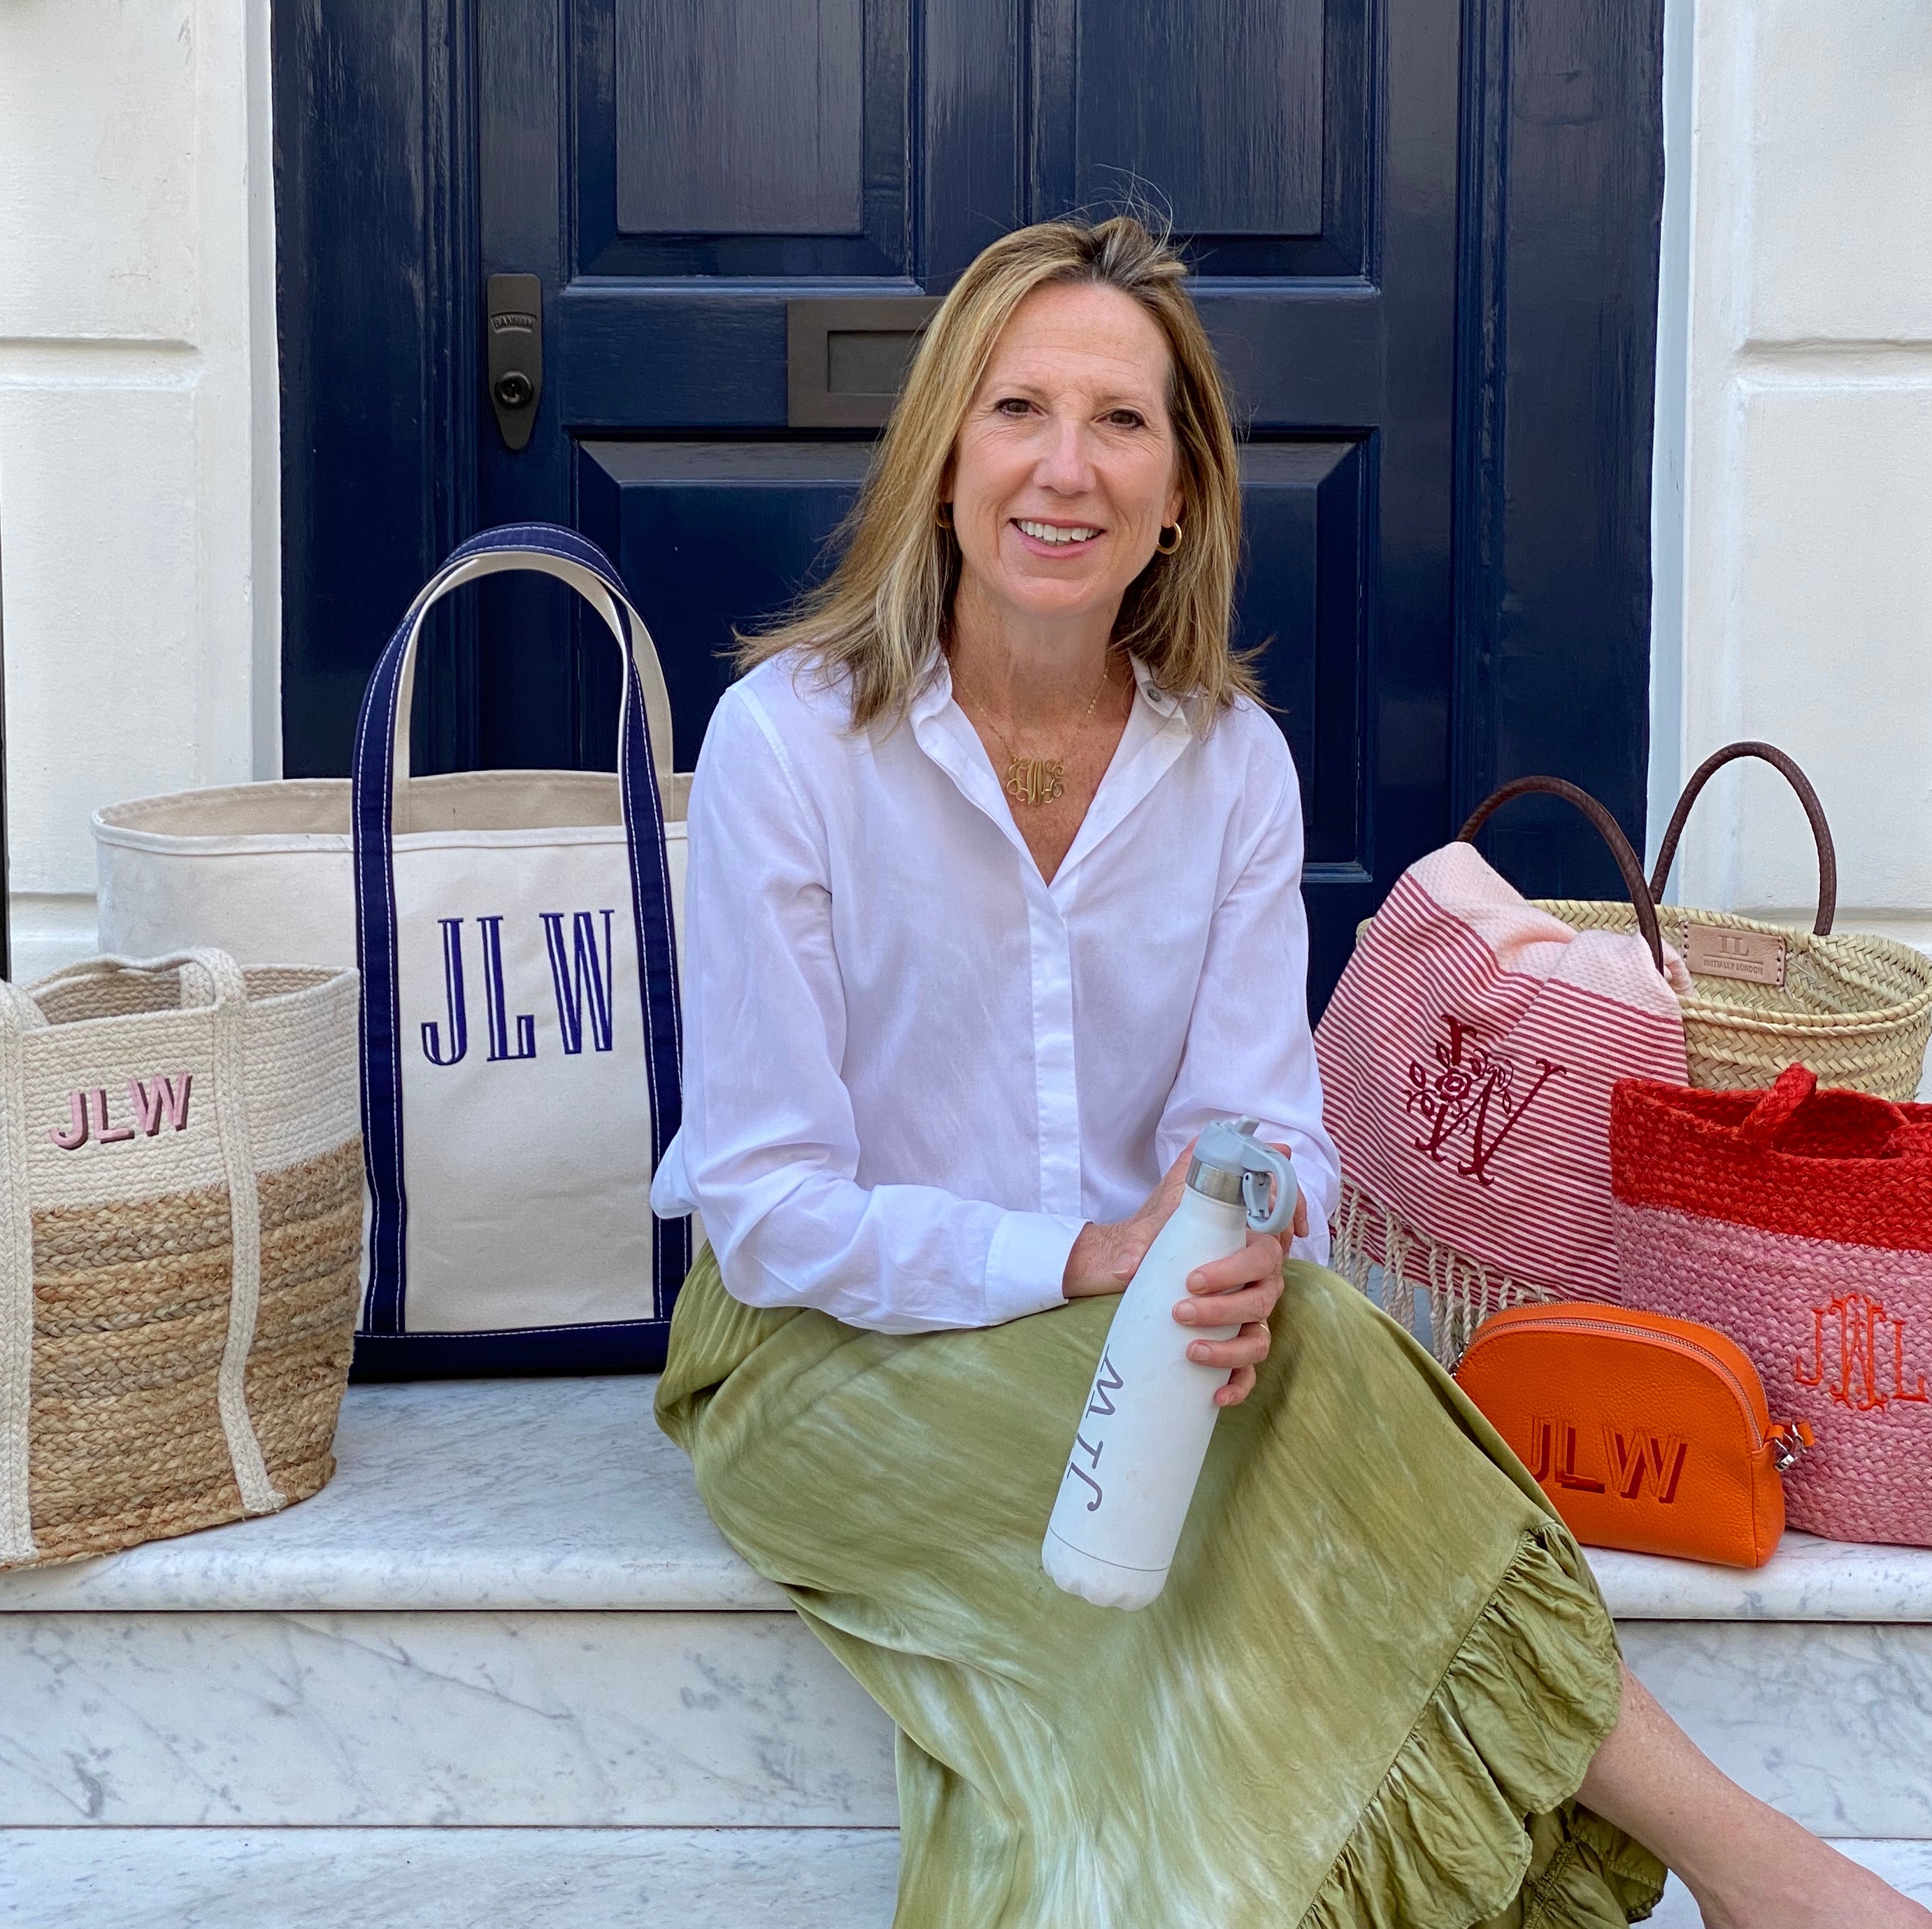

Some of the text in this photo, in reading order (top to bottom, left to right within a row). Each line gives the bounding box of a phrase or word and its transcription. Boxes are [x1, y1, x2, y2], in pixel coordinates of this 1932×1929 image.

[421, 909, 615, 1065] JLW
[1703, 959, 1763, 974] INITIALLY LONDON
[50, 1072, 193, 1151] JLW
[1067, 1344, 1124, 1511] JLW
[1529, 1417, 1688, 1504] JLW
